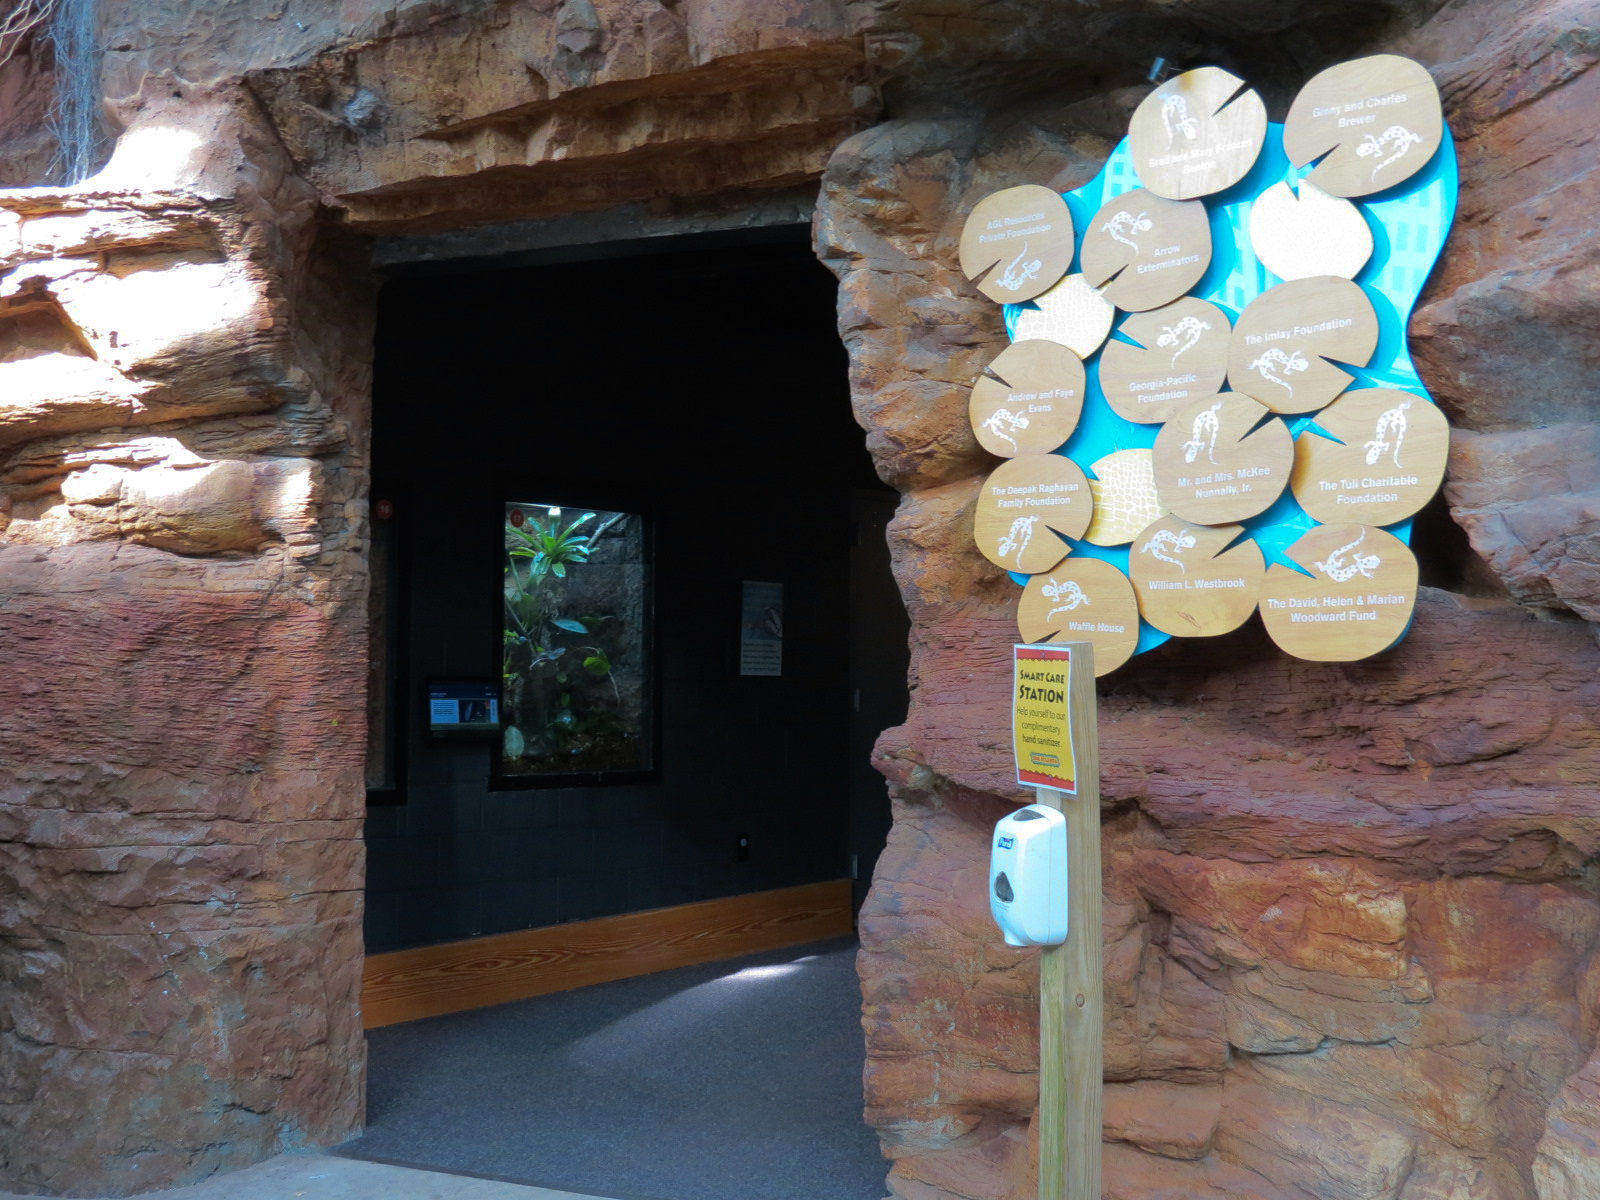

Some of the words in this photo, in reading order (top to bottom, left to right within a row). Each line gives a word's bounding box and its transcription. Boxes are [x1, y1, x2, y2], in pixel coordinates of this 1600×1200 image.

[1344, 101, 1364, 112] and
[1366, 93, 1408, 108] Charles
[1338, 114, 1376, 128] Brewer
[1007, 224, 1051, 240] Foundation
[1154, 244, 1181, 257] Arrow
[1137, 254, 1199, 274] Exterminators
[1245, 333, 1262, 345] The
[1294, 317, 1352, 336] Foundation
[1129, 374, 1197, 392] Georgia-Pacific
[1007, 392, 1037, 402] Andrew
[1038, 390, 1053, 400] and
[1055, 388, 1074, 400] Faye
[1137, 389, 1188, 404] Foundation
[1028, 404, 1052, 413] Evans
[1178, 476, 1194, 487] Mr.
[1197, 473, 1213, 484] and
[1215, 470, 1235, 482] Mrs.
[1237, 466, 1271, 479] McKee
[1319, 480, 1338, 491] The
[1361, 474, 1418, 488] Charitable
[992, 487, 1006, 496] The
[1008, 485, 1037, 497] Deepak
[1039, 482, 1079, 495] Raghavan
[998, 498, 1024, 509] Family
[1025, 495, 1071, 506] Foundation
[1337, 491, 1398, 504] Foundation
[1149, 580, 1183, 590] William
[1185, 580, 1193, 589] L.
[1195, 578, 1245, 589] Westbrook
[1268, 599, 1287, 609] The
[1289, 597, 1321, 608] David,
[1323, 596, 1354, 607] Helen
[1356, 597, 1364, 606] &
[1366, 594, 1405, 605] Marian
[1290, 611, 1348, 622] Woodward
[1349, 610, 1376, 621] Fund
[1069, 621, 1096, 632] Waffle
[1097, 622, 1125, 633] House
[1020, 669, 1045, 682] SMART
[1045, 672, 1064, 684] CARE
[1019, 684, 1064, 704] STATION
[1017, 706, 1028, 717] Help
[1029, 709, 1049, 719] yourself
[1022, 733, 1036, 744] hand
